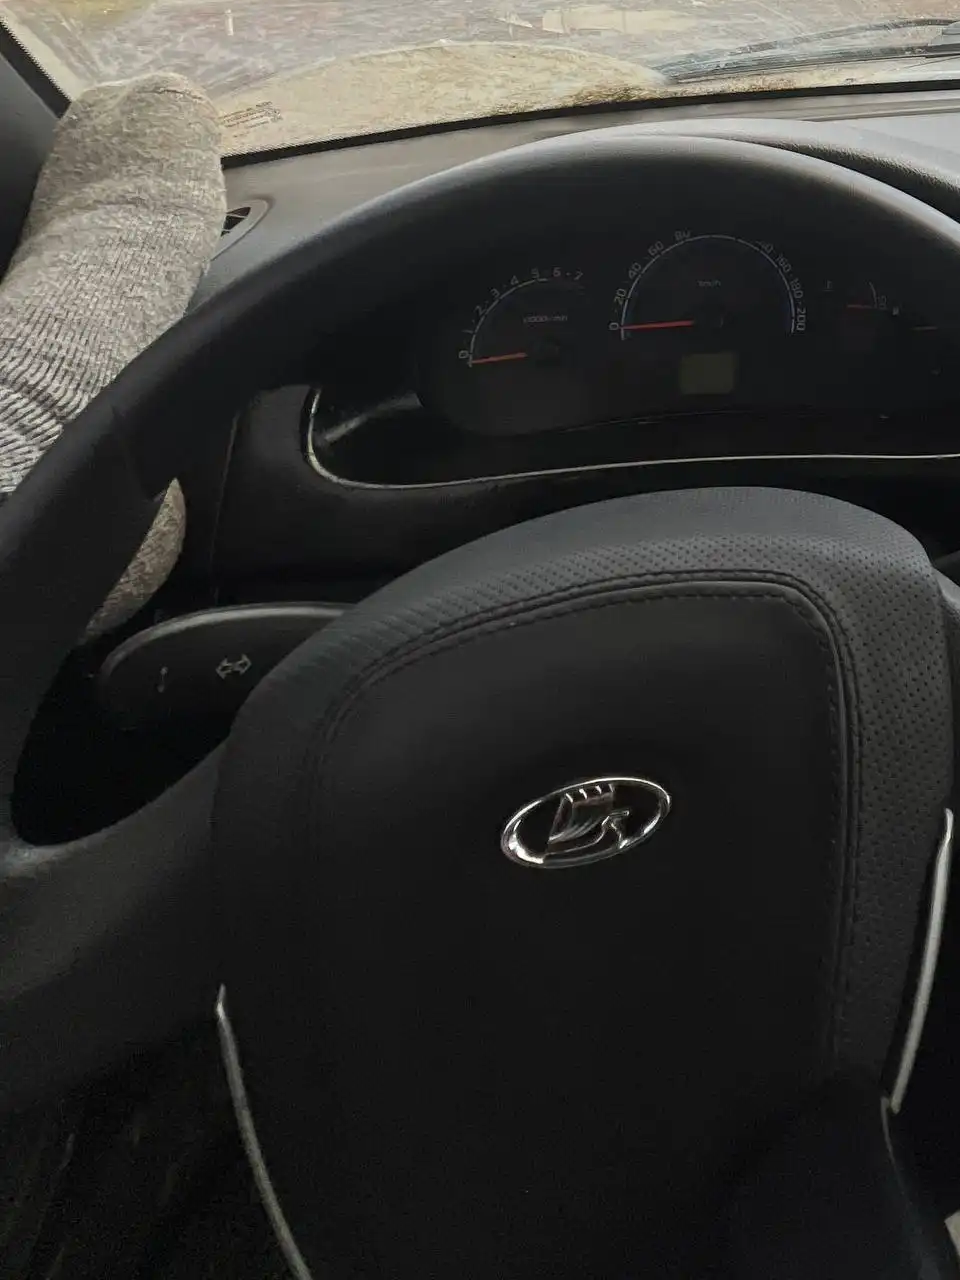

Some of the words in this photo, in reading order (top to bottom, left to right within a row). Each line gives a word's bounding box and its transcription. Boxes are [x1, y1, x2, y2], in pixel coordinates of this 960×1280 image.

[647, 240, 665, 257] 60
[628, 262, 642, 280] 40
[490, 288, 501, 299] 3
[510, 275, 519, 285] 4
[614, 288, 627, 305] 20
[609, 322, 620, 331] 0
[796, 307, 807, 331] 200
